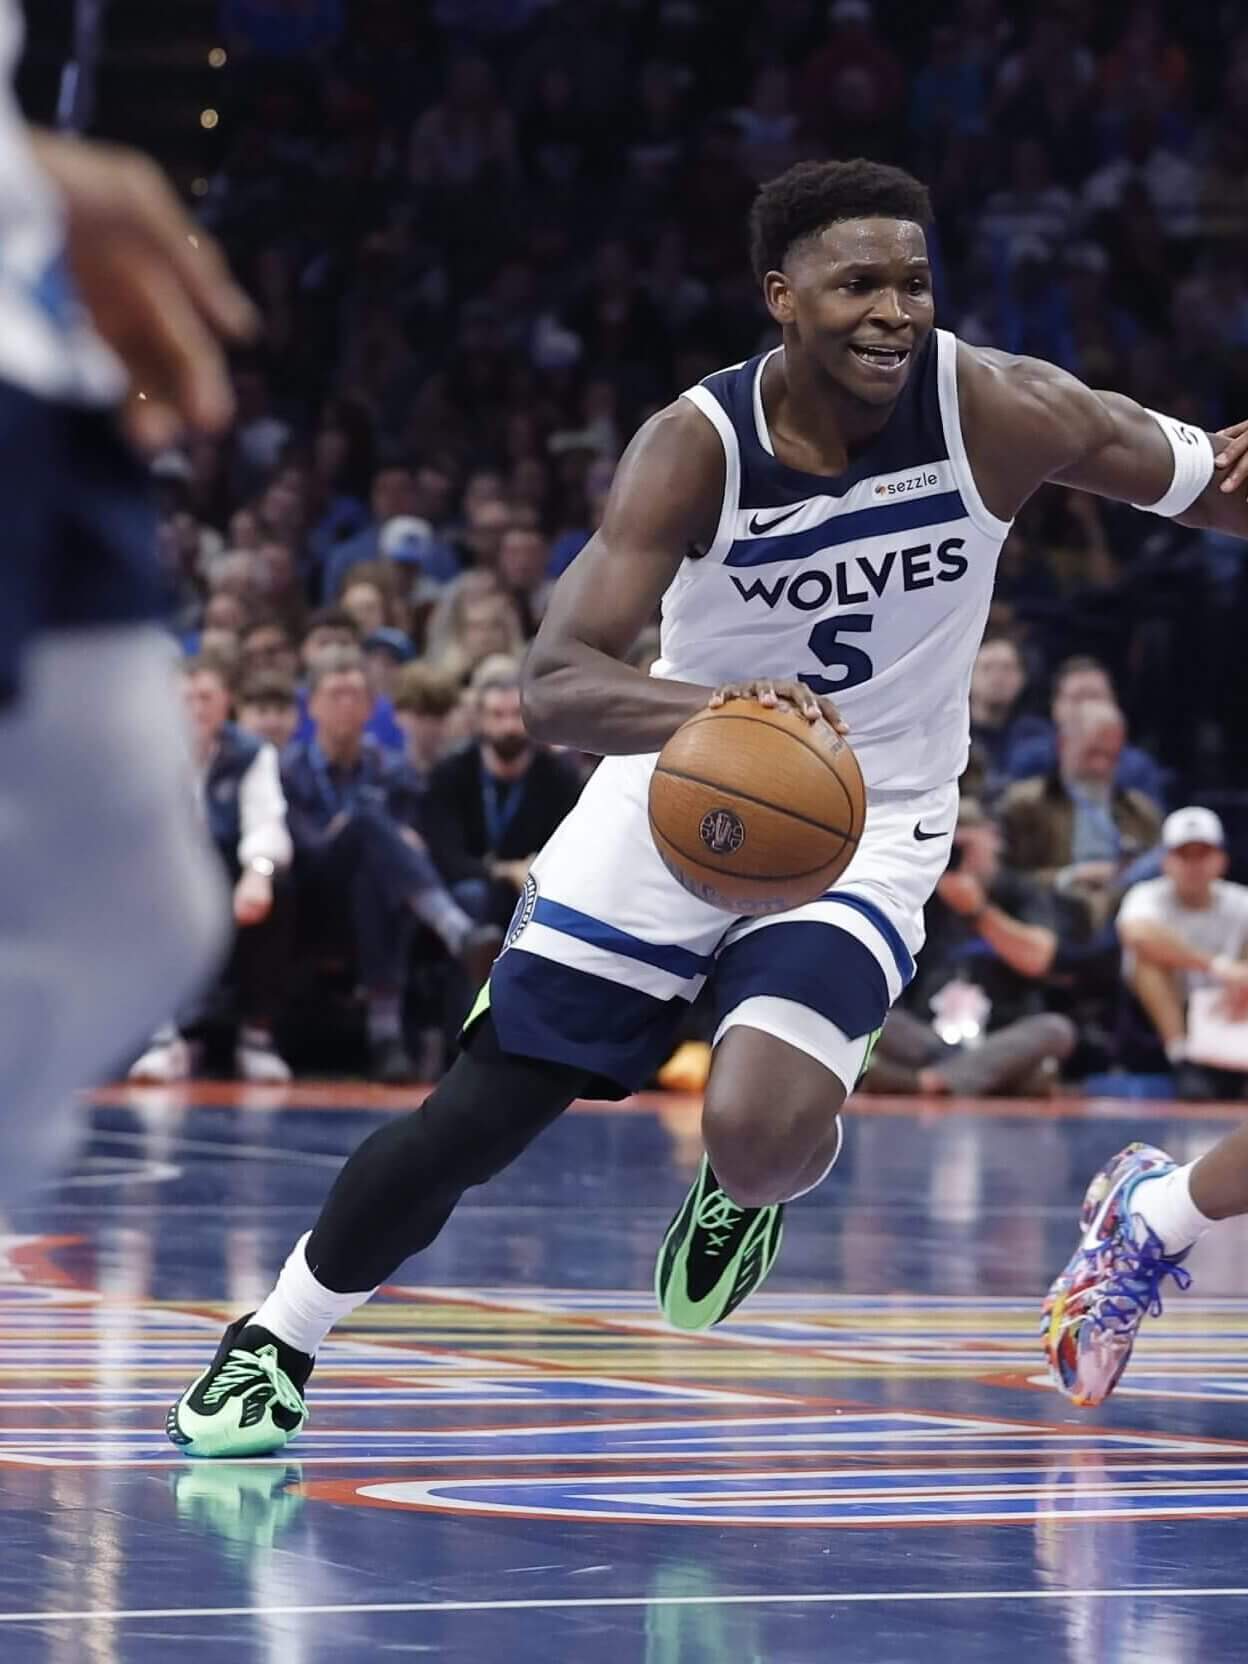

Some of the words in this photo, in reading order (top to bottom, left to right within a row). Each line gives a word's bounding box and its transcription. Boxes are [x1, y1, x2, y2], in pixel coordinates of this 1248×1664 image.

[887, 471, 938, 495] sezzle
[729, 537, 968, 611] WOLVES
[797, 613, 874, 695] 5
